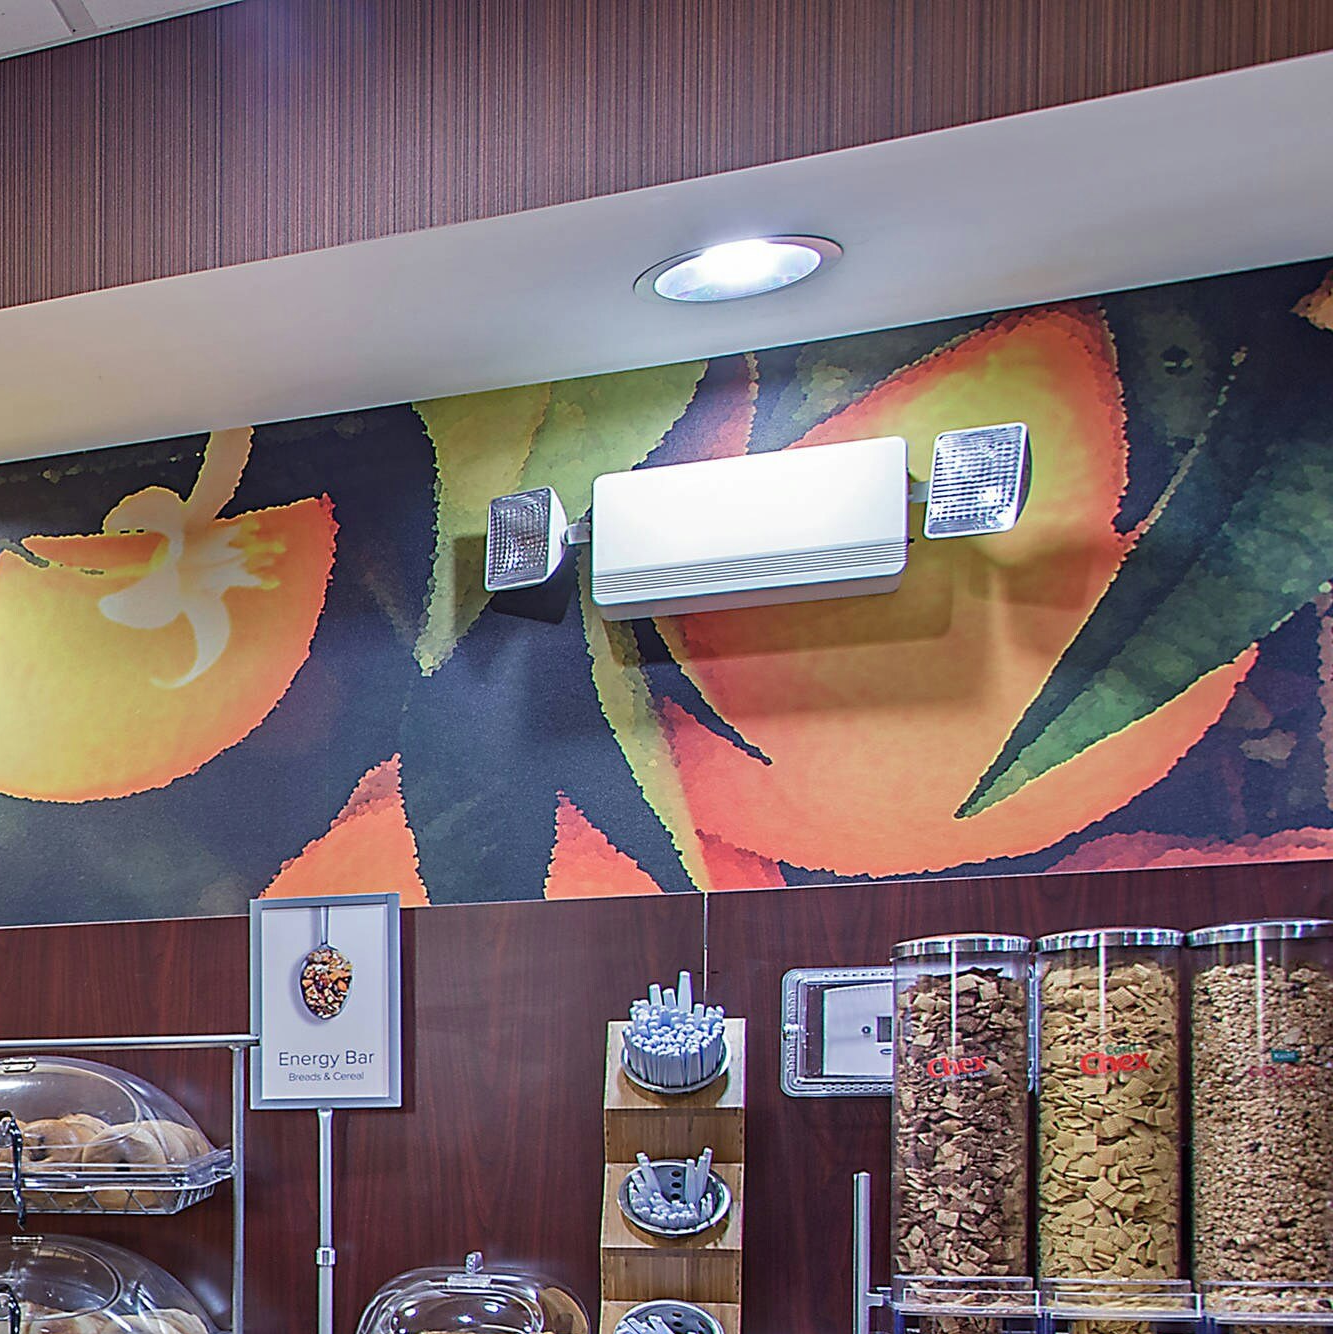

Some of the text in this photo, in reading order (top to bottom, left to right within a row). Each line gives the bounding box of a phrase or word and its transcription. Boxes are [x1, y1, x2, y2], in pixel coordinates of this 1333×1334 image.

[278, 1049, 375, 1069] Energy Bar
[927, 1056, 988, 1078] Chex
[1080, 1052, 1150, 1075] Chex
[288, 1071, 364, 1082] Breads & Cereal
